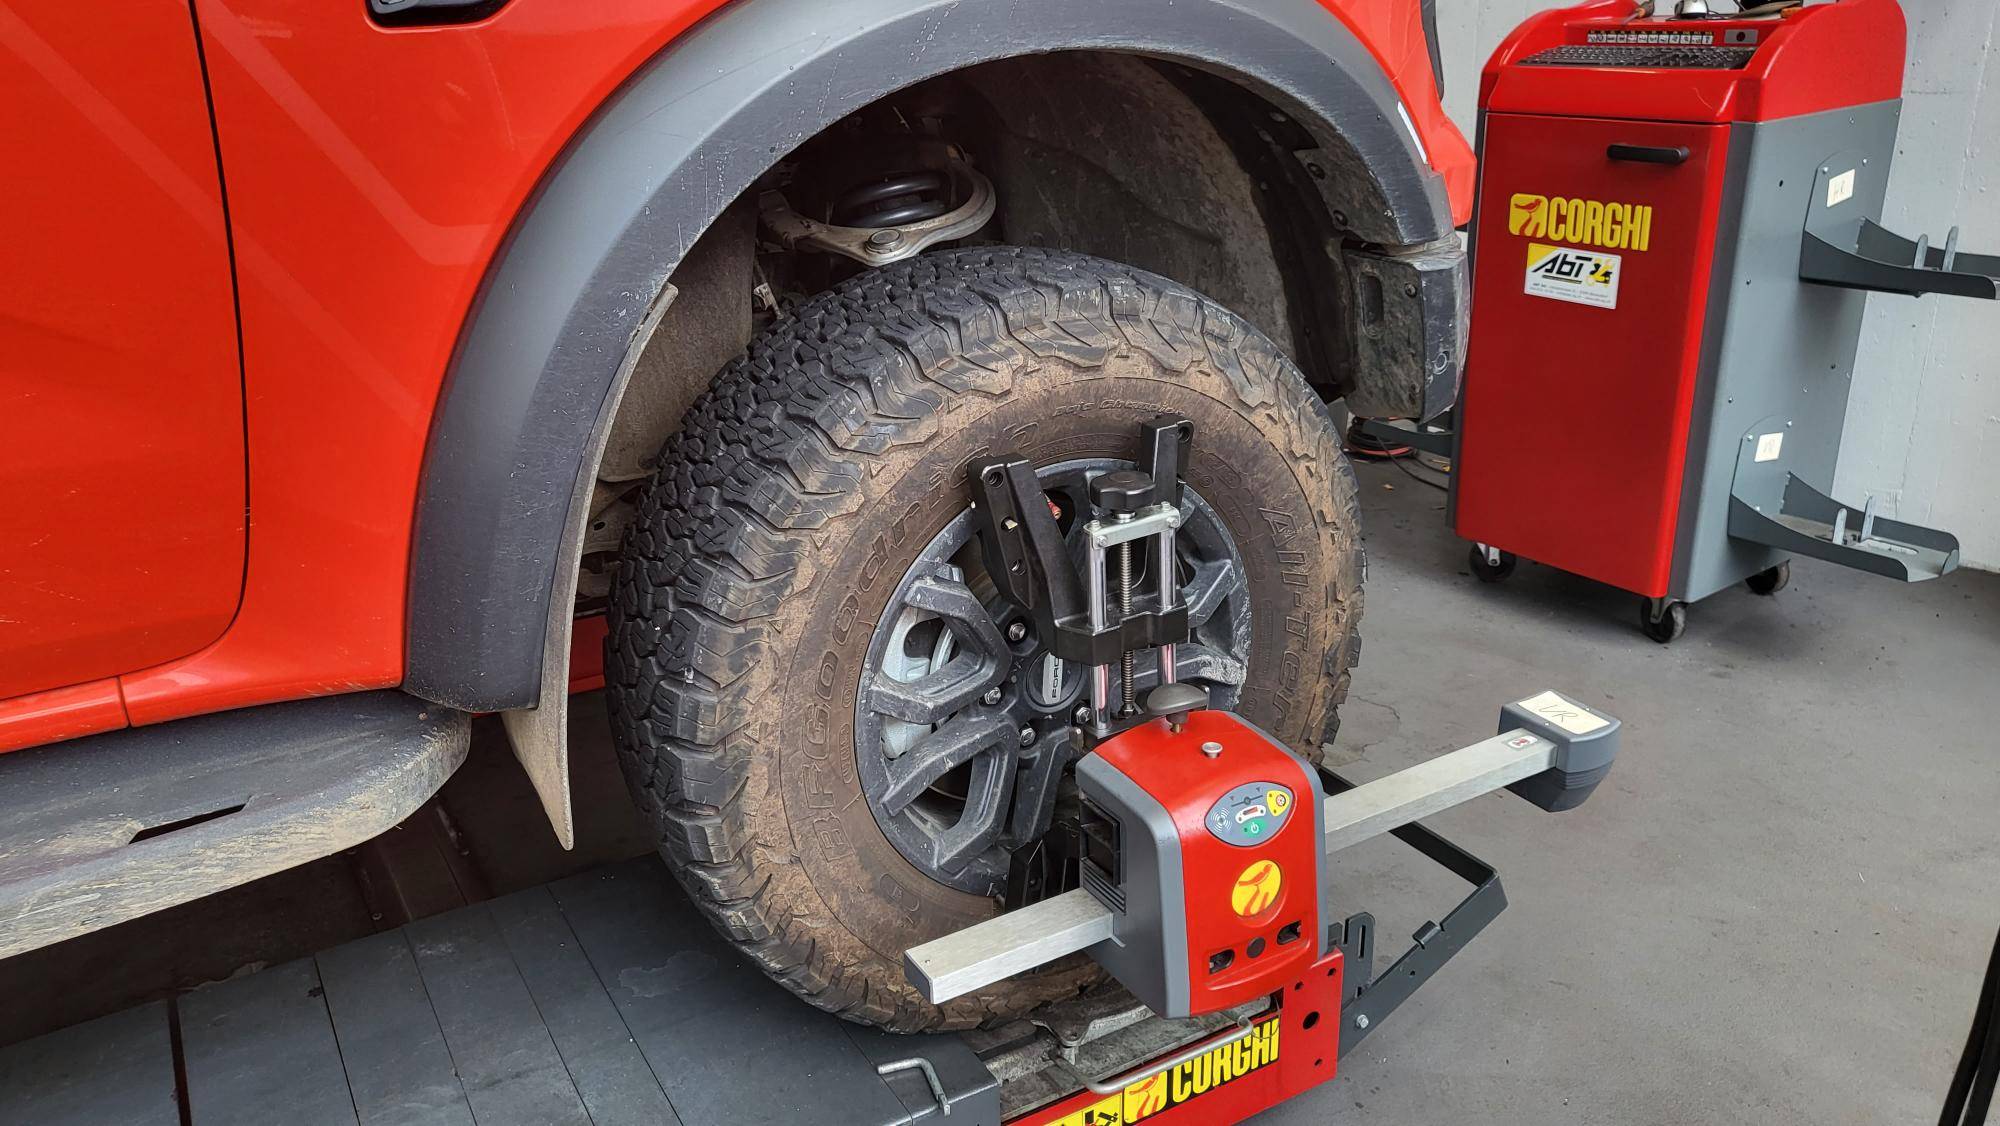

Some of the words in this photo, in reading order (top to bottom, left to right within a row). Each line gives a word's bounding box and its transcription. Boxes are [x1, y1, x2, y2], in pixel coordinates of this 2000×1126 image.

[1547, 196, 1653, 252] CORGHI
[1538, 704, 1579, 723] VR
[1171, 1017, 1281, 1105] CORGHI
